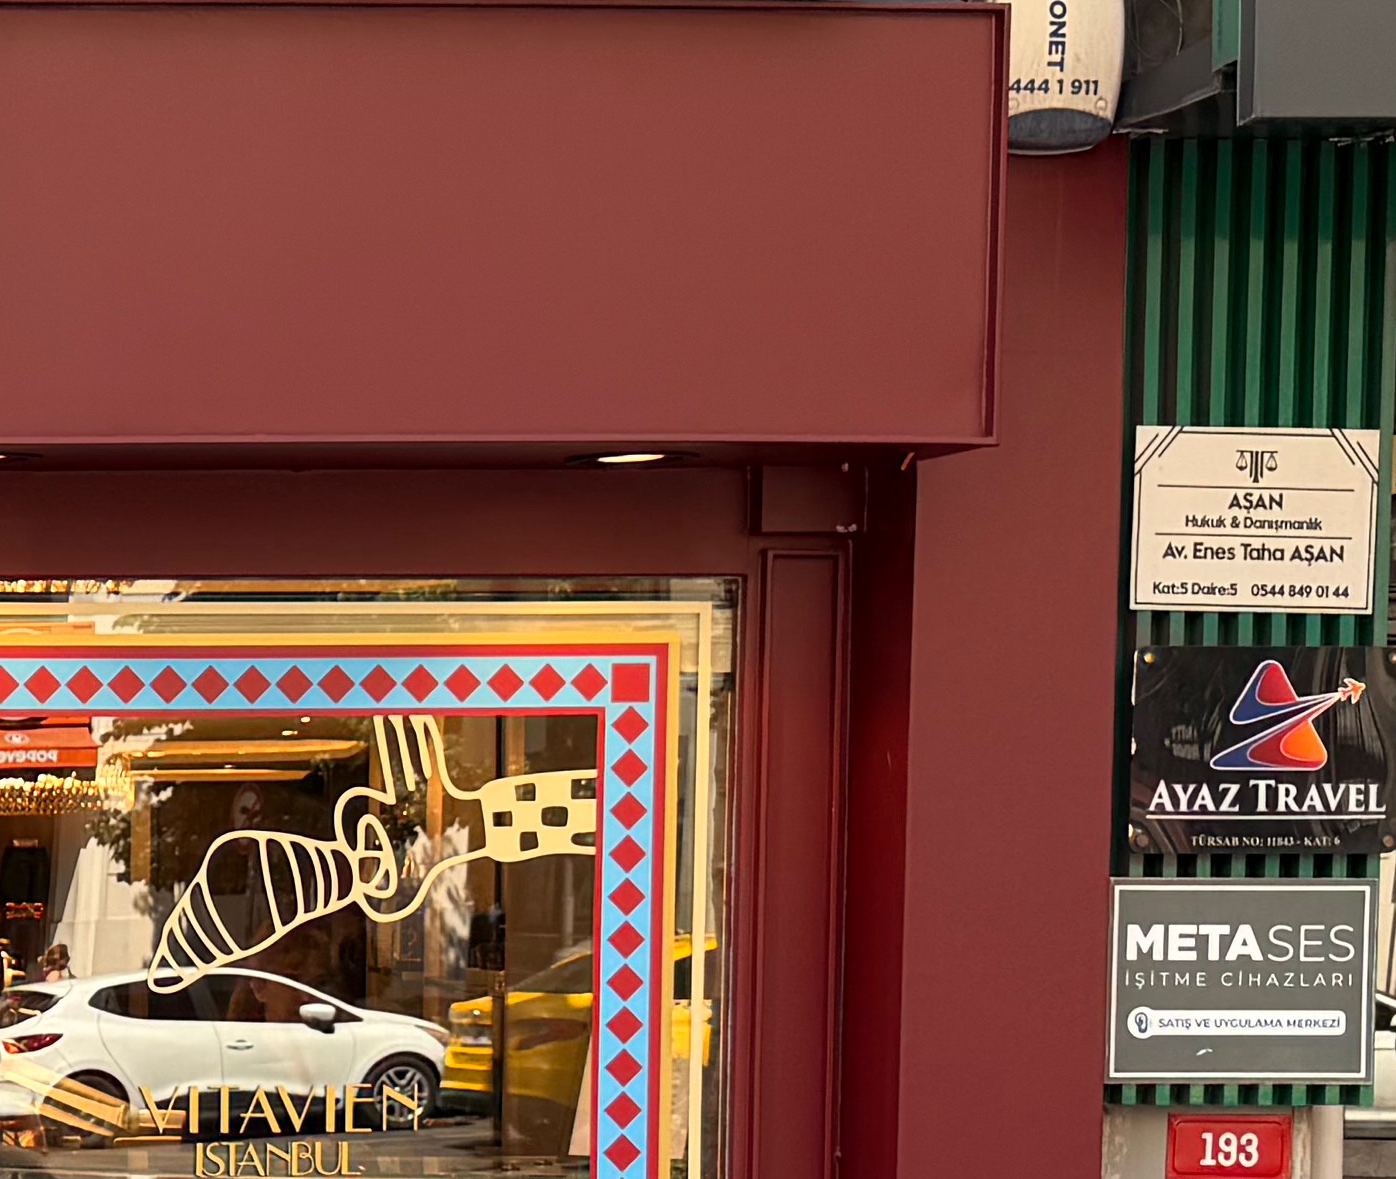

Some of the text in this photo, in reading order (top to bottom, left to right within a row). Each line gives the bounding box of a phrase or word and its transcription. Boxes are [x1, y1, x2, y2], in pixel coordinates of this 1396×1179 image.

[1009, 78, 1099, 96] 444 1 911
[1228, 492, 1283, 514] AŞAN
[1185, 515, 1322, 533] Hukuk & Danışmanlık
[1162, 542, 1344, 566] Av. Enes Taha AŞAN
[1152, 582, 1349, 598] Kat:5 Daire:5 0544 849 01 44
[1148, 779, 1387, 812] AYAZ TRAVEL
[1191, 834, 1239, 847] TÜRSAB
[1126, 924, 1355, 962] METASES
[1125, 968, 1353, 989] İŞİTME CİHAZLARI
[1158, 1016, 1340, 1031] SATIŞ VE UYGULAMA MERKEZİ
[139, 1084, 419, 1134] VITAVIEN
[195, 1141, 360, 1178] ISTANBUL
[1200, 1132, 1259, 1167] 193
